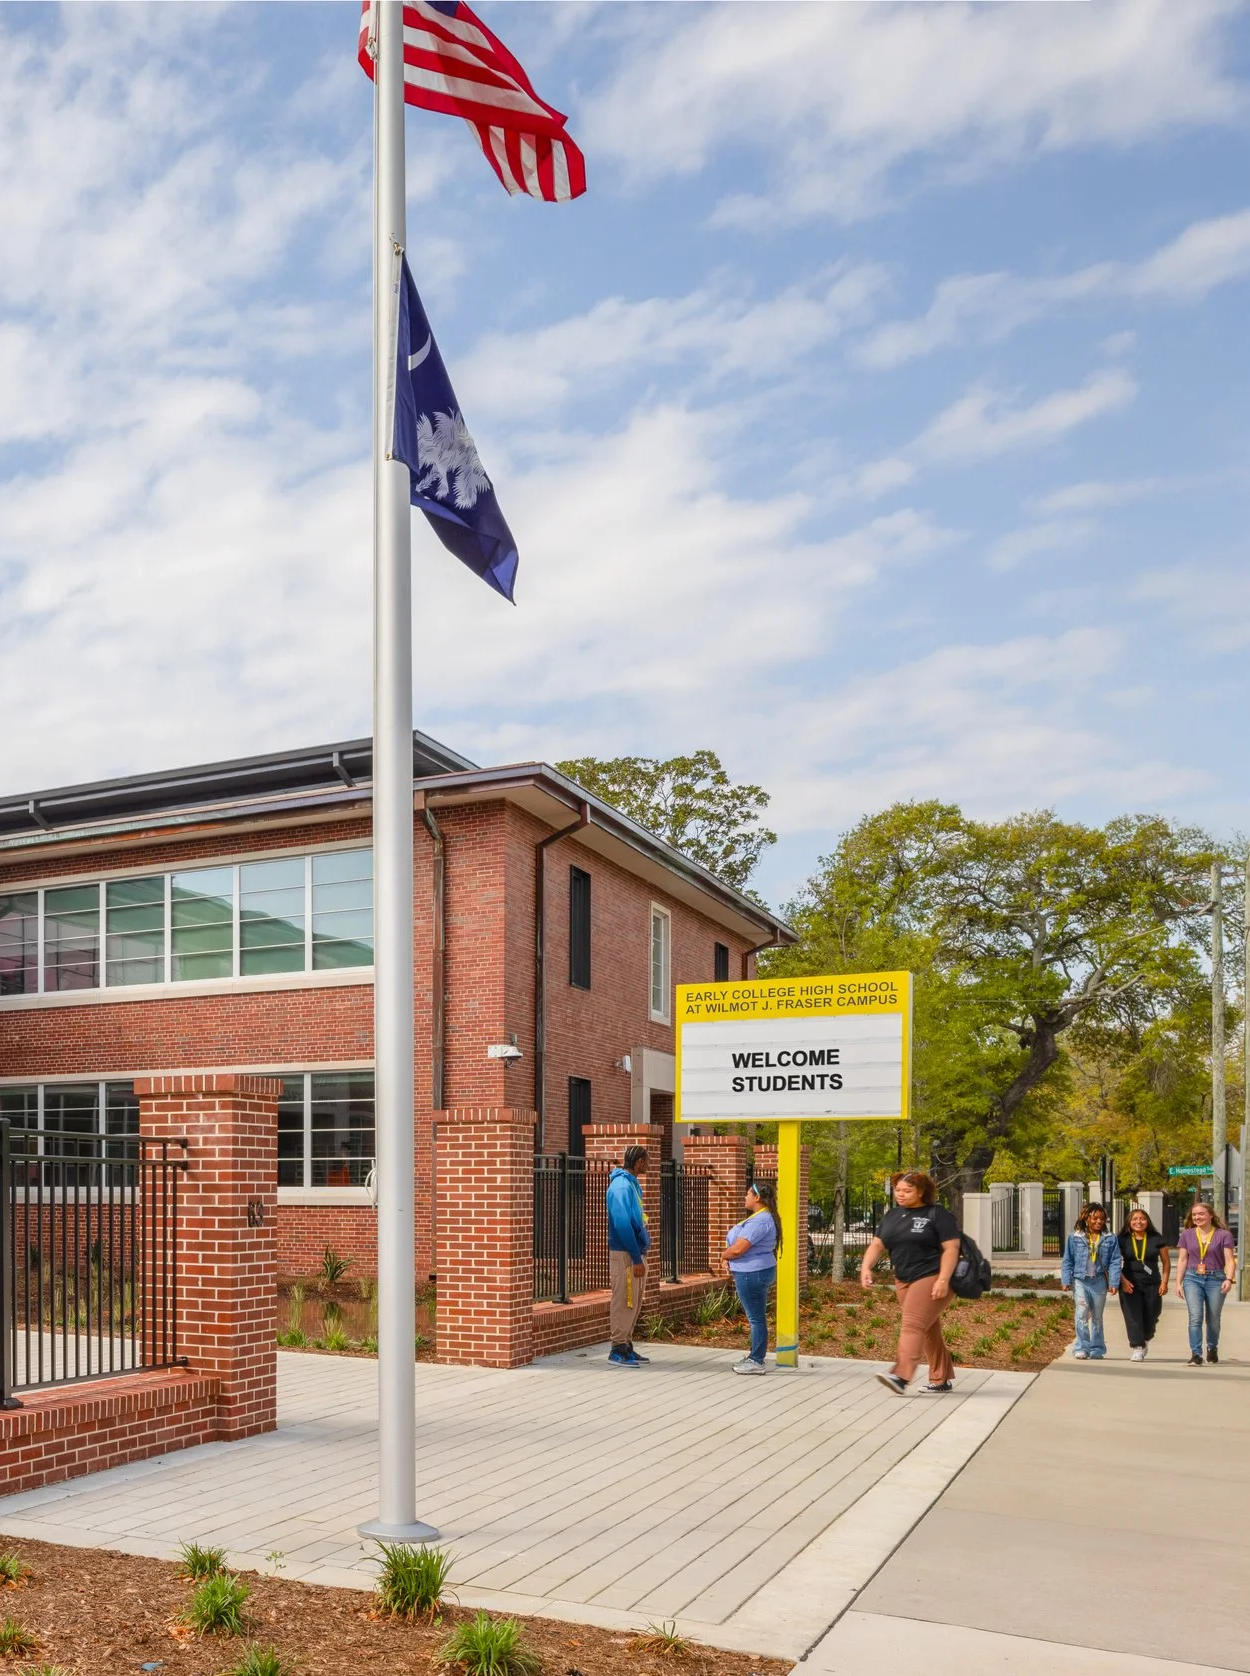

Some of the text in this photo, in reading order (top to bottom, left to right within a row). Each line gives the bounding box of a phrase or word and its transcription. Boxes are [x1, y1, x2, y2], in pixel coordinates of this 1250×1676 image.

[686, 981, 898, 1002] EARLY COLLEGE HIGH SCHOOL
[686, 994, 897, 1015] AT WILMOT J. FRASER CAMPUS
[732, 1049, 840, 1069] WELCOME
[731, 1073, 843, 1093] STUDENTS
[1176, 1166, 1206, 1175] Hampstead
